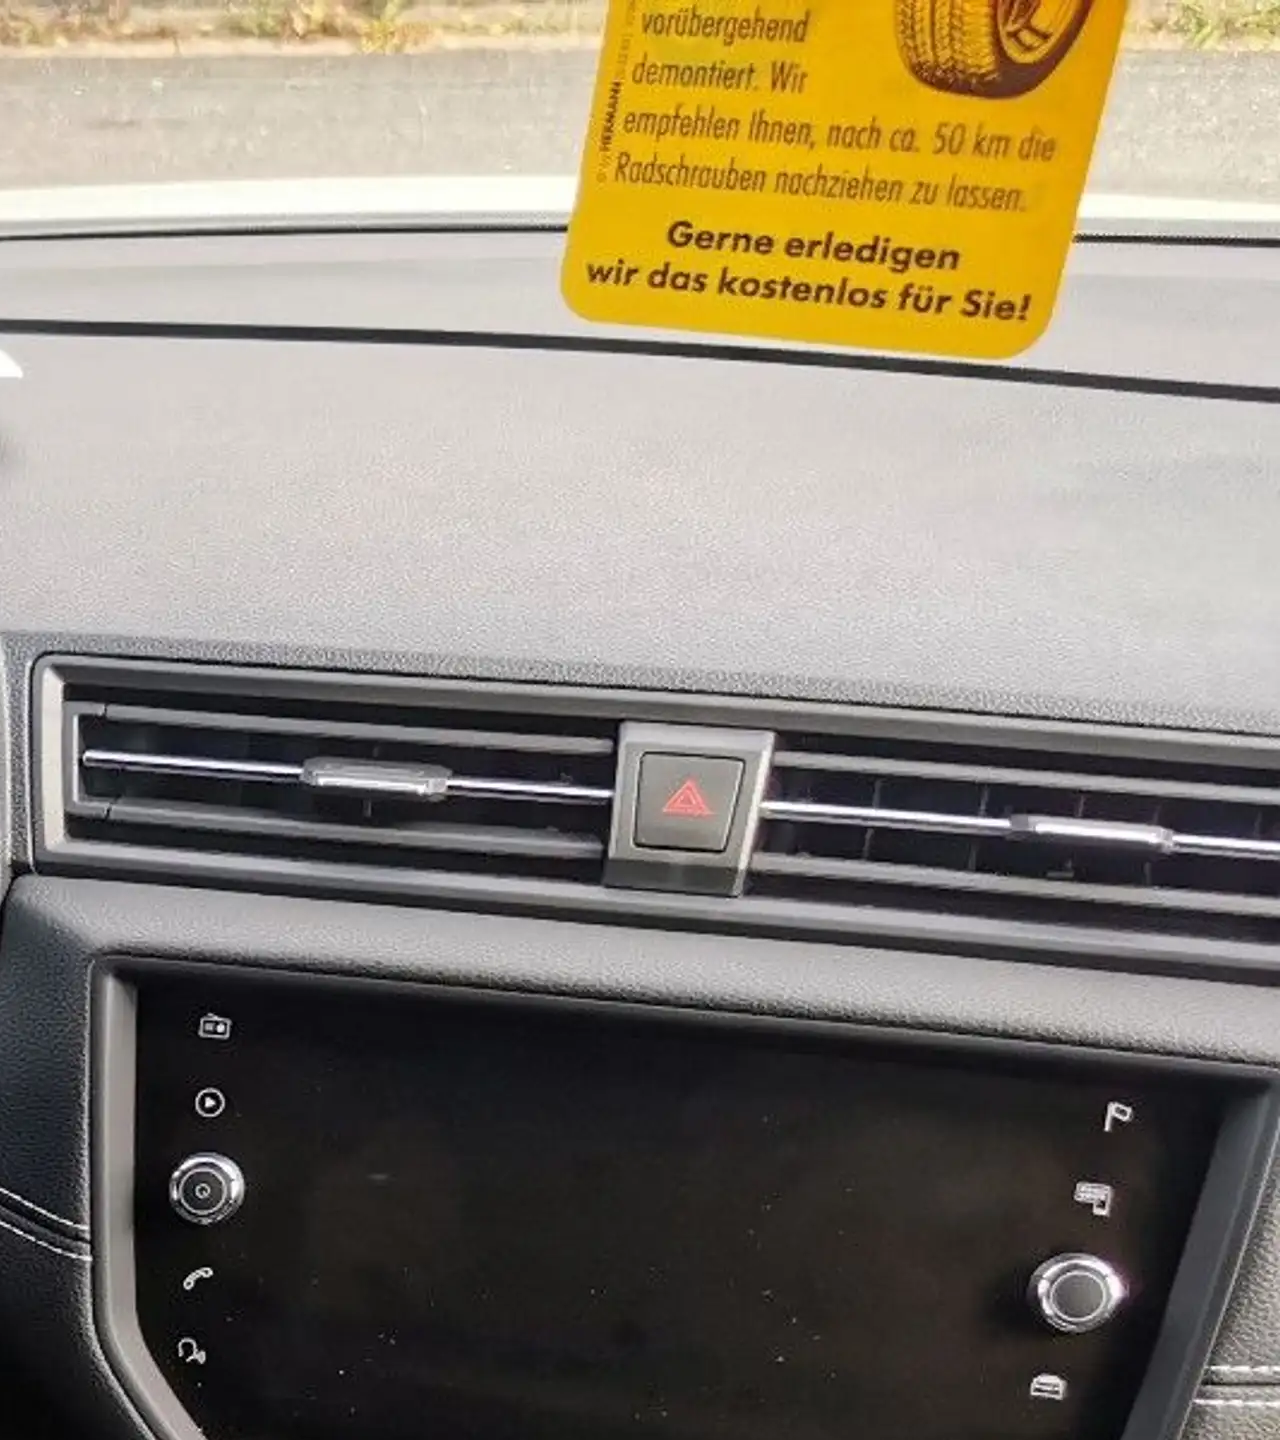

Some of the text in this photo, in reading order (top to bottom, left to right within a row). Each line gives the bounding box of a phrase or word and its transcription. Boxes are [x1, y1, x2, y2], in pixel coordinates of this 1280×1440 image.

[641, 6, 811, 46] vorübergehend
[631, 52, 809, 94] demontiert. Wir
[623, 102, 1058, 162] empfehlen Ihnen, nach ca. 50 km die
[614, 152, 1028, 213] Radschrauben nachziehen zu lassen.
[666, 220, 961, 274] Gerne erledigen
[586, 258, 1032, 323] wir das kostenlos für Sie!
